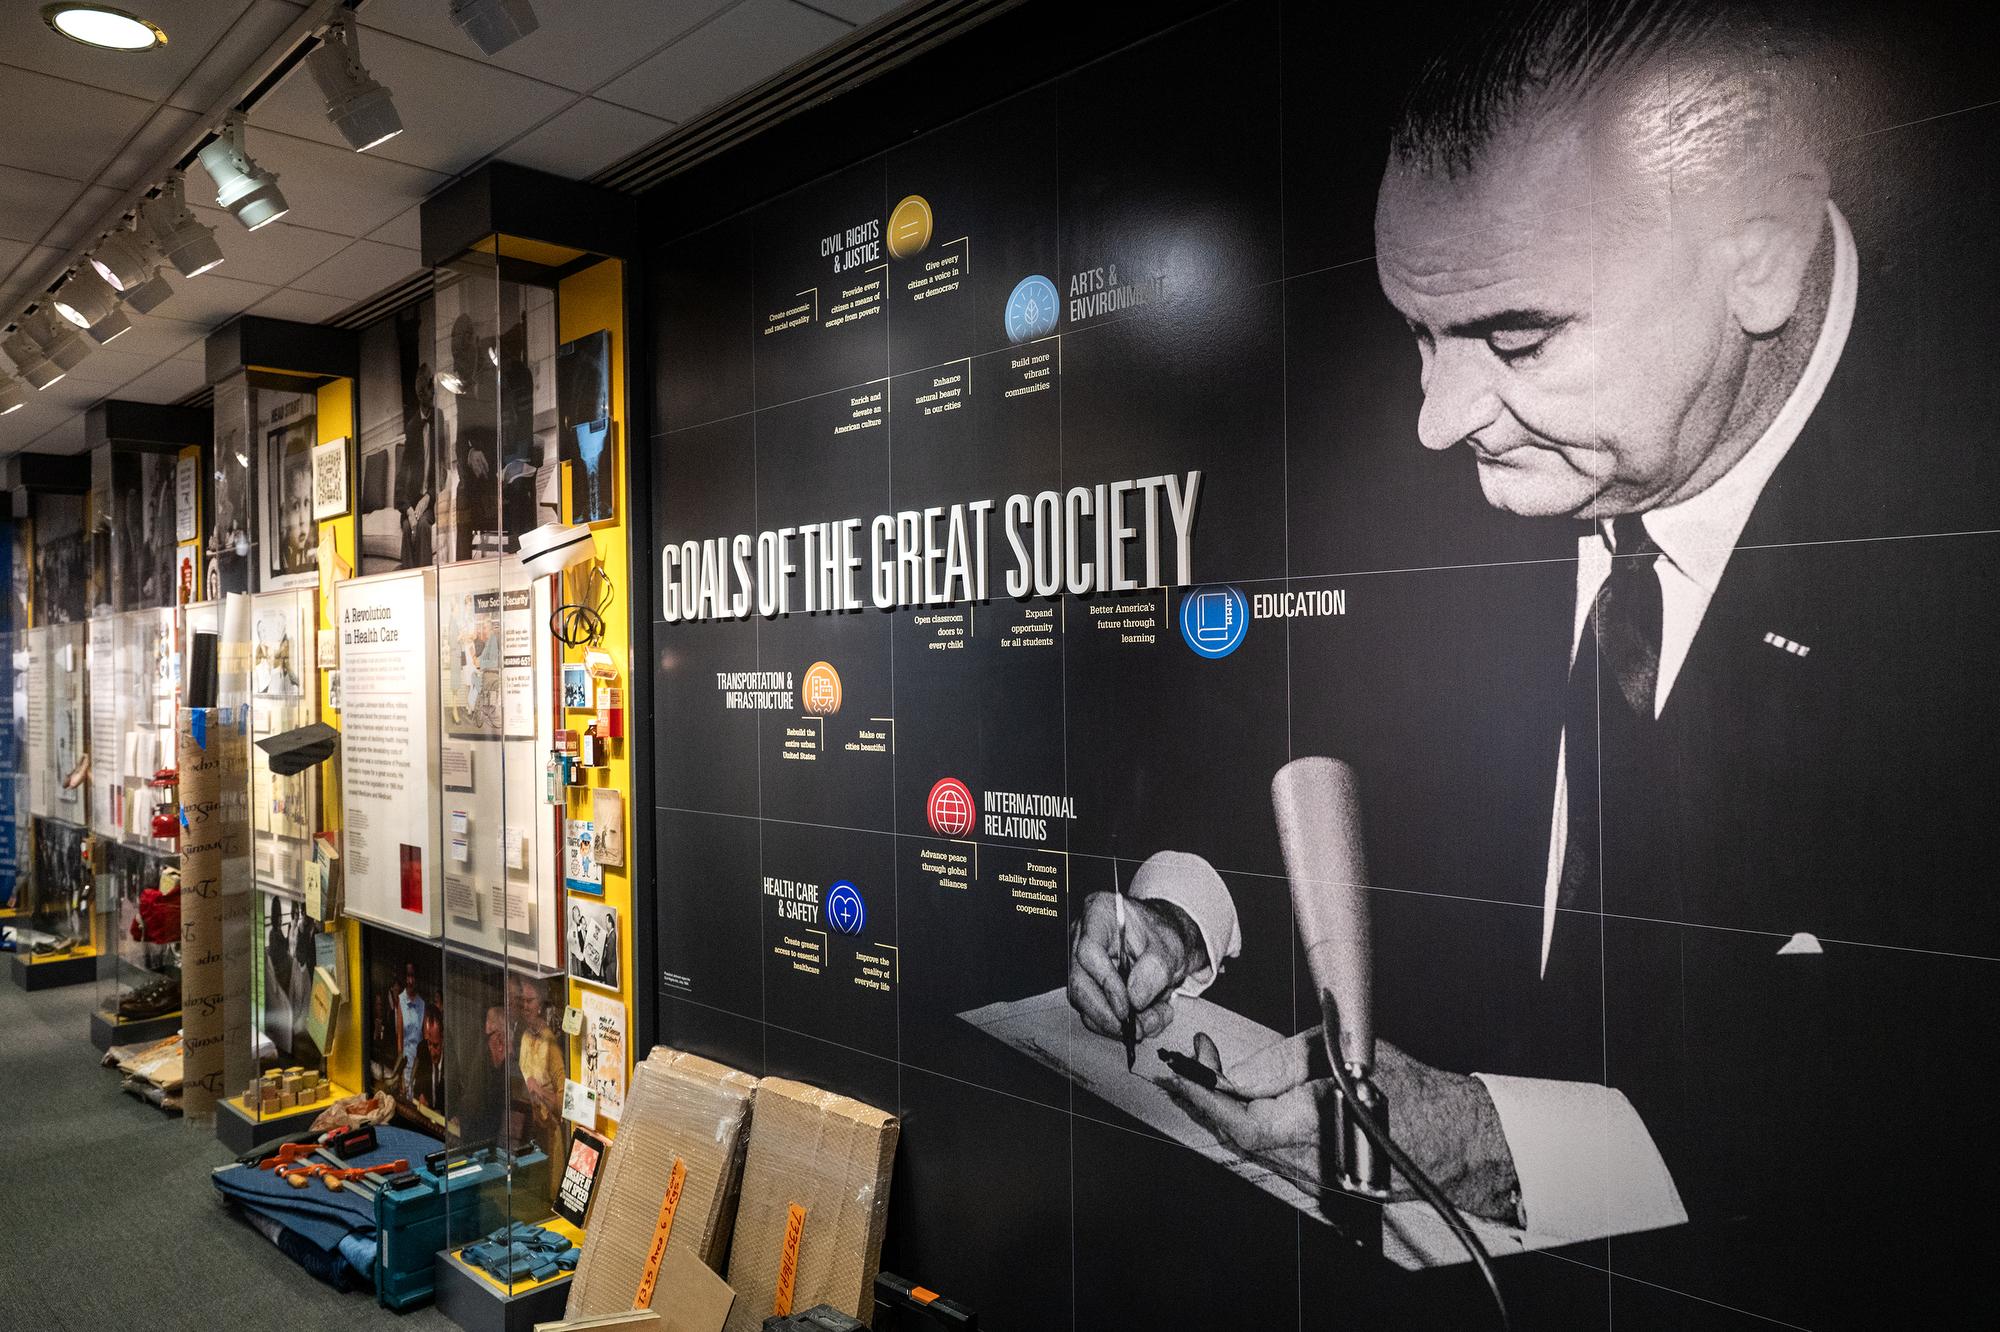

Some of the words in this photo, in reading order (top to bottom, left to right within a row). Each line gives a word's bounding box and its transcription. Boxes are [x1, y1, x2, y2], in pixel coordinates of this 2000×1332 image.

[821, 233, 844, 257] CIVIL
[846, 219, 879, 248] RIGHTS
[834, 255, 840, 273] &
[843, 240, 880, 270] JUSTICE
[925, 260, 940, 271] Give
[940, 254, 959, 267] every
[908, 277, 928, 290] citizen
[934, 271, 950, 282] voice
[951, 268, 959, 278] in
[1070, 268, 1104, 297] ARTS
[1109, 264, 1117, 286] &
[842, 285, 863, 299] Provide
[864, 281, 880, 291] every
[913, 292, 924, 301] our
[925, 281, 959, 299] democracy
[831, 302, 849, 314] citizen
[854, 297, 873, 307] means
[874, 292, 880, 300] of
[1070, 275, 1167, 322] ENVIRONMT
[769, 312, 785, 322] Create
[786, 303, 810, 316] economic
[825, 317, 844, 328] escape
[844, 313, 858, 323] from
[858, 306, 880, 320] poverty
[764, 326, 774, 335] and
[774, 321, 788, 333] racial
[789, 315, 810, 329] equality
[1011, 359, 1029, 369] Build
[1031, 353, 1050, 365] more
[933, 374, 961, 388] Enhance
[1024, 367, 1050, 380] vibrant
[915, 391, 938, 405] natural
[939, 387, 961, 402] beauty
[1004, 380, 1050, 398] communities
[850, 394, 870, 407] Enrich
[870, 391, 882, 402] and
[852, 408, 873, 418] elevate
[873, 406, 882, 414] an
[924, 406, 932, 416] in
[932, 405, 943, 414] our
[944, 400, 961, 411] cities
[834, 421, 861, 435] American
[861, 417, 882, 428] culture
[661, 533, 752, 623] GOALS
[757, 527, 796, 617] OF
[799, 518, 864, 613] THE
[871, 499, 996, 609] GREAT
[1005, 469, 1202, 599] SOCIETY
[489, 596, 506, 608] Socil
[1089, 604, 1114, 615] Better
[1115, 603, 1155, 614] America's
[1254, 589, 1346, 619] EDUCATION
[344, 608, 350, 623] A
[352, 604, 392, 623] Revolution
[914, 616, 931, 625] Open
[932, 614, 963, 623] classroom
[1025, 609, 1053, 620] Expand
[937, 627, 955, 636] doors
[956, 627, 964, 635] to
[1011, 623, 1053, 634] opportunity
[1097, 619, 1122, 629] future
[1122, 618, 1155, 630] through
[344, 629, 352, 645] in
[353, 627, 378, 644] Health
[380, 626, 399, 642] Care
[1001, 638, 1011, 648] for
[1012, 638, 1021, 647] all
[1022, 637, 1054, 647] students
[1121, 634, 1156, 645] learning
[928, 642, 946, 651] every
[947, 640, 964, 649] child
[716, 672, 785, 690] TRANSPORTATION
[787, 672, 793, 690] &
[726, 691, 794, 710] INFRASTRUCTURE
[786, 728, 806, 737] Rebuild
[807, 729, 816, 737] the
[859, 730, 875, 739] Make
[785, 740, 800, 748] entire
[800, 741, 816, 749] urban
[845, 743, 860, 751] cities
[860, 743, 886, 752] beautiful
[782, 751, 799, 760] United
[800, 752, 816, 761] States
[984, 790, 1078, 819] INTERNATIONAL
[985, 814, 1047, 841] RELATIONS
[920, 849, 948, 861] Advance
[948, 854, 967, 863] peace
[922, 862, 947, 875] through
[947, 865, 968, 877] global
[1027, 862, 1057, 874] Promote
[939, 878, 968, 890] alliances
[998, 873, 1028, 886] stability
[1028, 876, 1058, 889] through
[763, 876, 794, 899] HEALTH
[796, 882, 819, 904] CARE
[1012, 888, 1058, 903] international
[778, 899, 785, 917] &
[786, 900, 819, 924] SAFETY
[1016, 903, 1058, 917] cooperation
[784, 936, 801, 947] Create
[801, 941, 820, 951] greater
[774, 946, 791, 957] access
[797, 951, 820, 963] essential
[856, 951, 879, 964] Improve
[879, 957, 890, 967] the
[793, 961, 820, 975] healthcare
[862, 967, 883, 978] quality
[883, 971, 890, 979] of
[854, 977, 879, 990] everyday
[880, 982, 890, 992] life
[660, 1221, 667, 1229] 6
